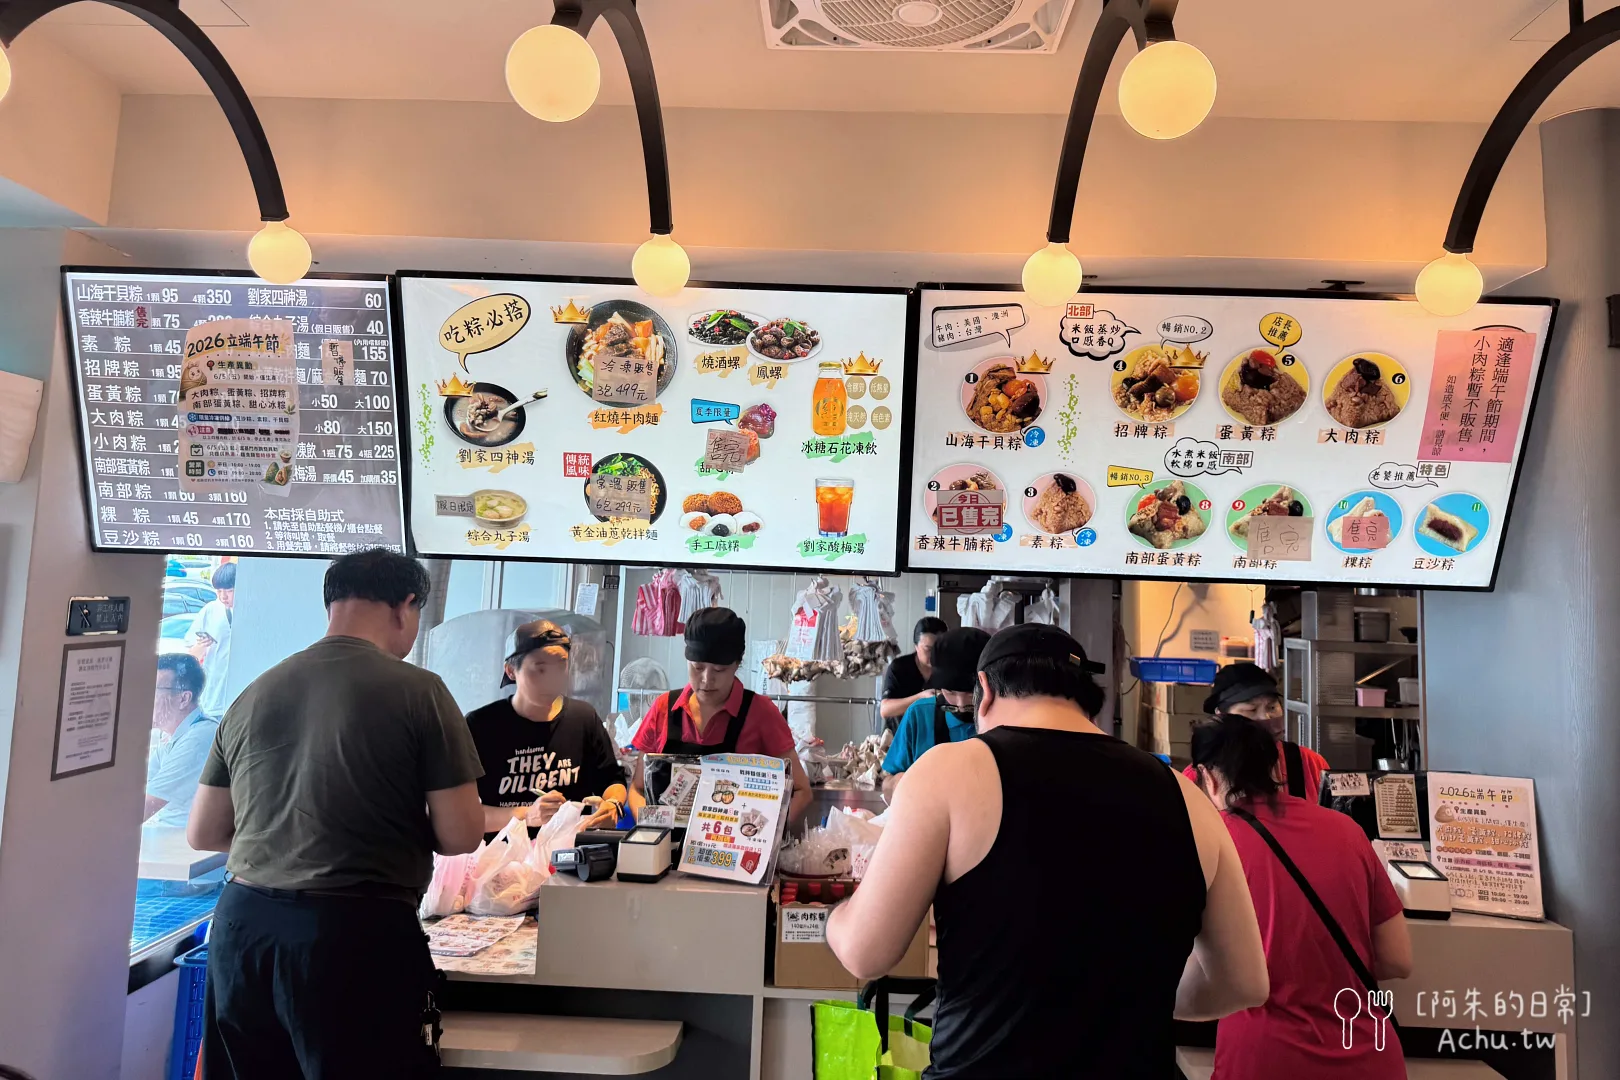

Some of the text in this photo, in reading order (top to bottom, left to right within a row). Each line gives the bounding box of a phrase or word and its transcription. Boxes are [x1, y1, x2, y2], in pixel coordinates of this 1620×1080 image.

[77, 284, 143, 301] 山海干貝粽
[248, 287, 382, 308] 劉家四神湯 60
[135, 306, 149, 329] 售完
[1067, 305, 1092, 317] 北部
[367, 320, 384, 335] 40
[443, 298, 524, 344] 吃粽必搭
[1272, 315, 1293, 331] 店長
[1071, 323, 1121, 336] 米飯蒸炒
[1267, 326, 1289, 342] 推薦
[362, 346, 387, 360] 155
[84, 359, 140, 377] 招牌粽
[600, 359, 654, 376] 冷凍販售
[701, 355, 741, 370] 燒酒螺
[370, 371, 388, 385] 70
[756, 366, 783, 379] 鳳螺
[87, 384, 142, 403] 蛋黃粽
[90, 408, 144, 427] 大肉粽
[594, 411, 659, 425] 紅燒牛肉麵
[695, 407, 732, 418] 夏季限量
[1115, 423, 1168, 440] 招牌粽
[1219, 424, 1276, 441] 蛋黃粽
[1324, 428, 1380, 444] 大肉粽
[93, 433, 147, 452] 小肉粽
[801, 441, 878, 456] 冰糖石花凍飲
[946, 434, 1022, 451] 山海干貝粽
[458, 448, 536, 466] 劉家四神湯
[565, 454, 590, 466] 傳統
[1171, 449, 1218, 460] 水煮米飯
[1222, 452, 1250, 466] 南部
[94, 457, 151, 476] 南部蛋黃粽
[565, 465, 590, 476] 風味
[1419, 463, 1447, 477] 特色
[97, 481, 152, 500] 南部粽
[958, 494, 979, 504] 今日
[264, 507, 345, 522] 本店採自助式
[941, 506, 1000, 527] 已售完
[102, 529, 160, 546] 豆沙粽
[467, 529, 531, 543] 綜合丸子湯
[917, 534, 994, 552] 香辣牛腩粽
[1031, 536, 1065, 550] 素粽
[803, 540, 865, 555] 劉家酸梅湯
[1125, 551, 1202, 567] 南部蛋黃粽
[1412, 558, 1455, 571] 豆沙粽
[515, 746, 545, 755] handsome
[507, 752, 572, 774] THEY ARE
[498, 766, 580, 795] DILIGENT
